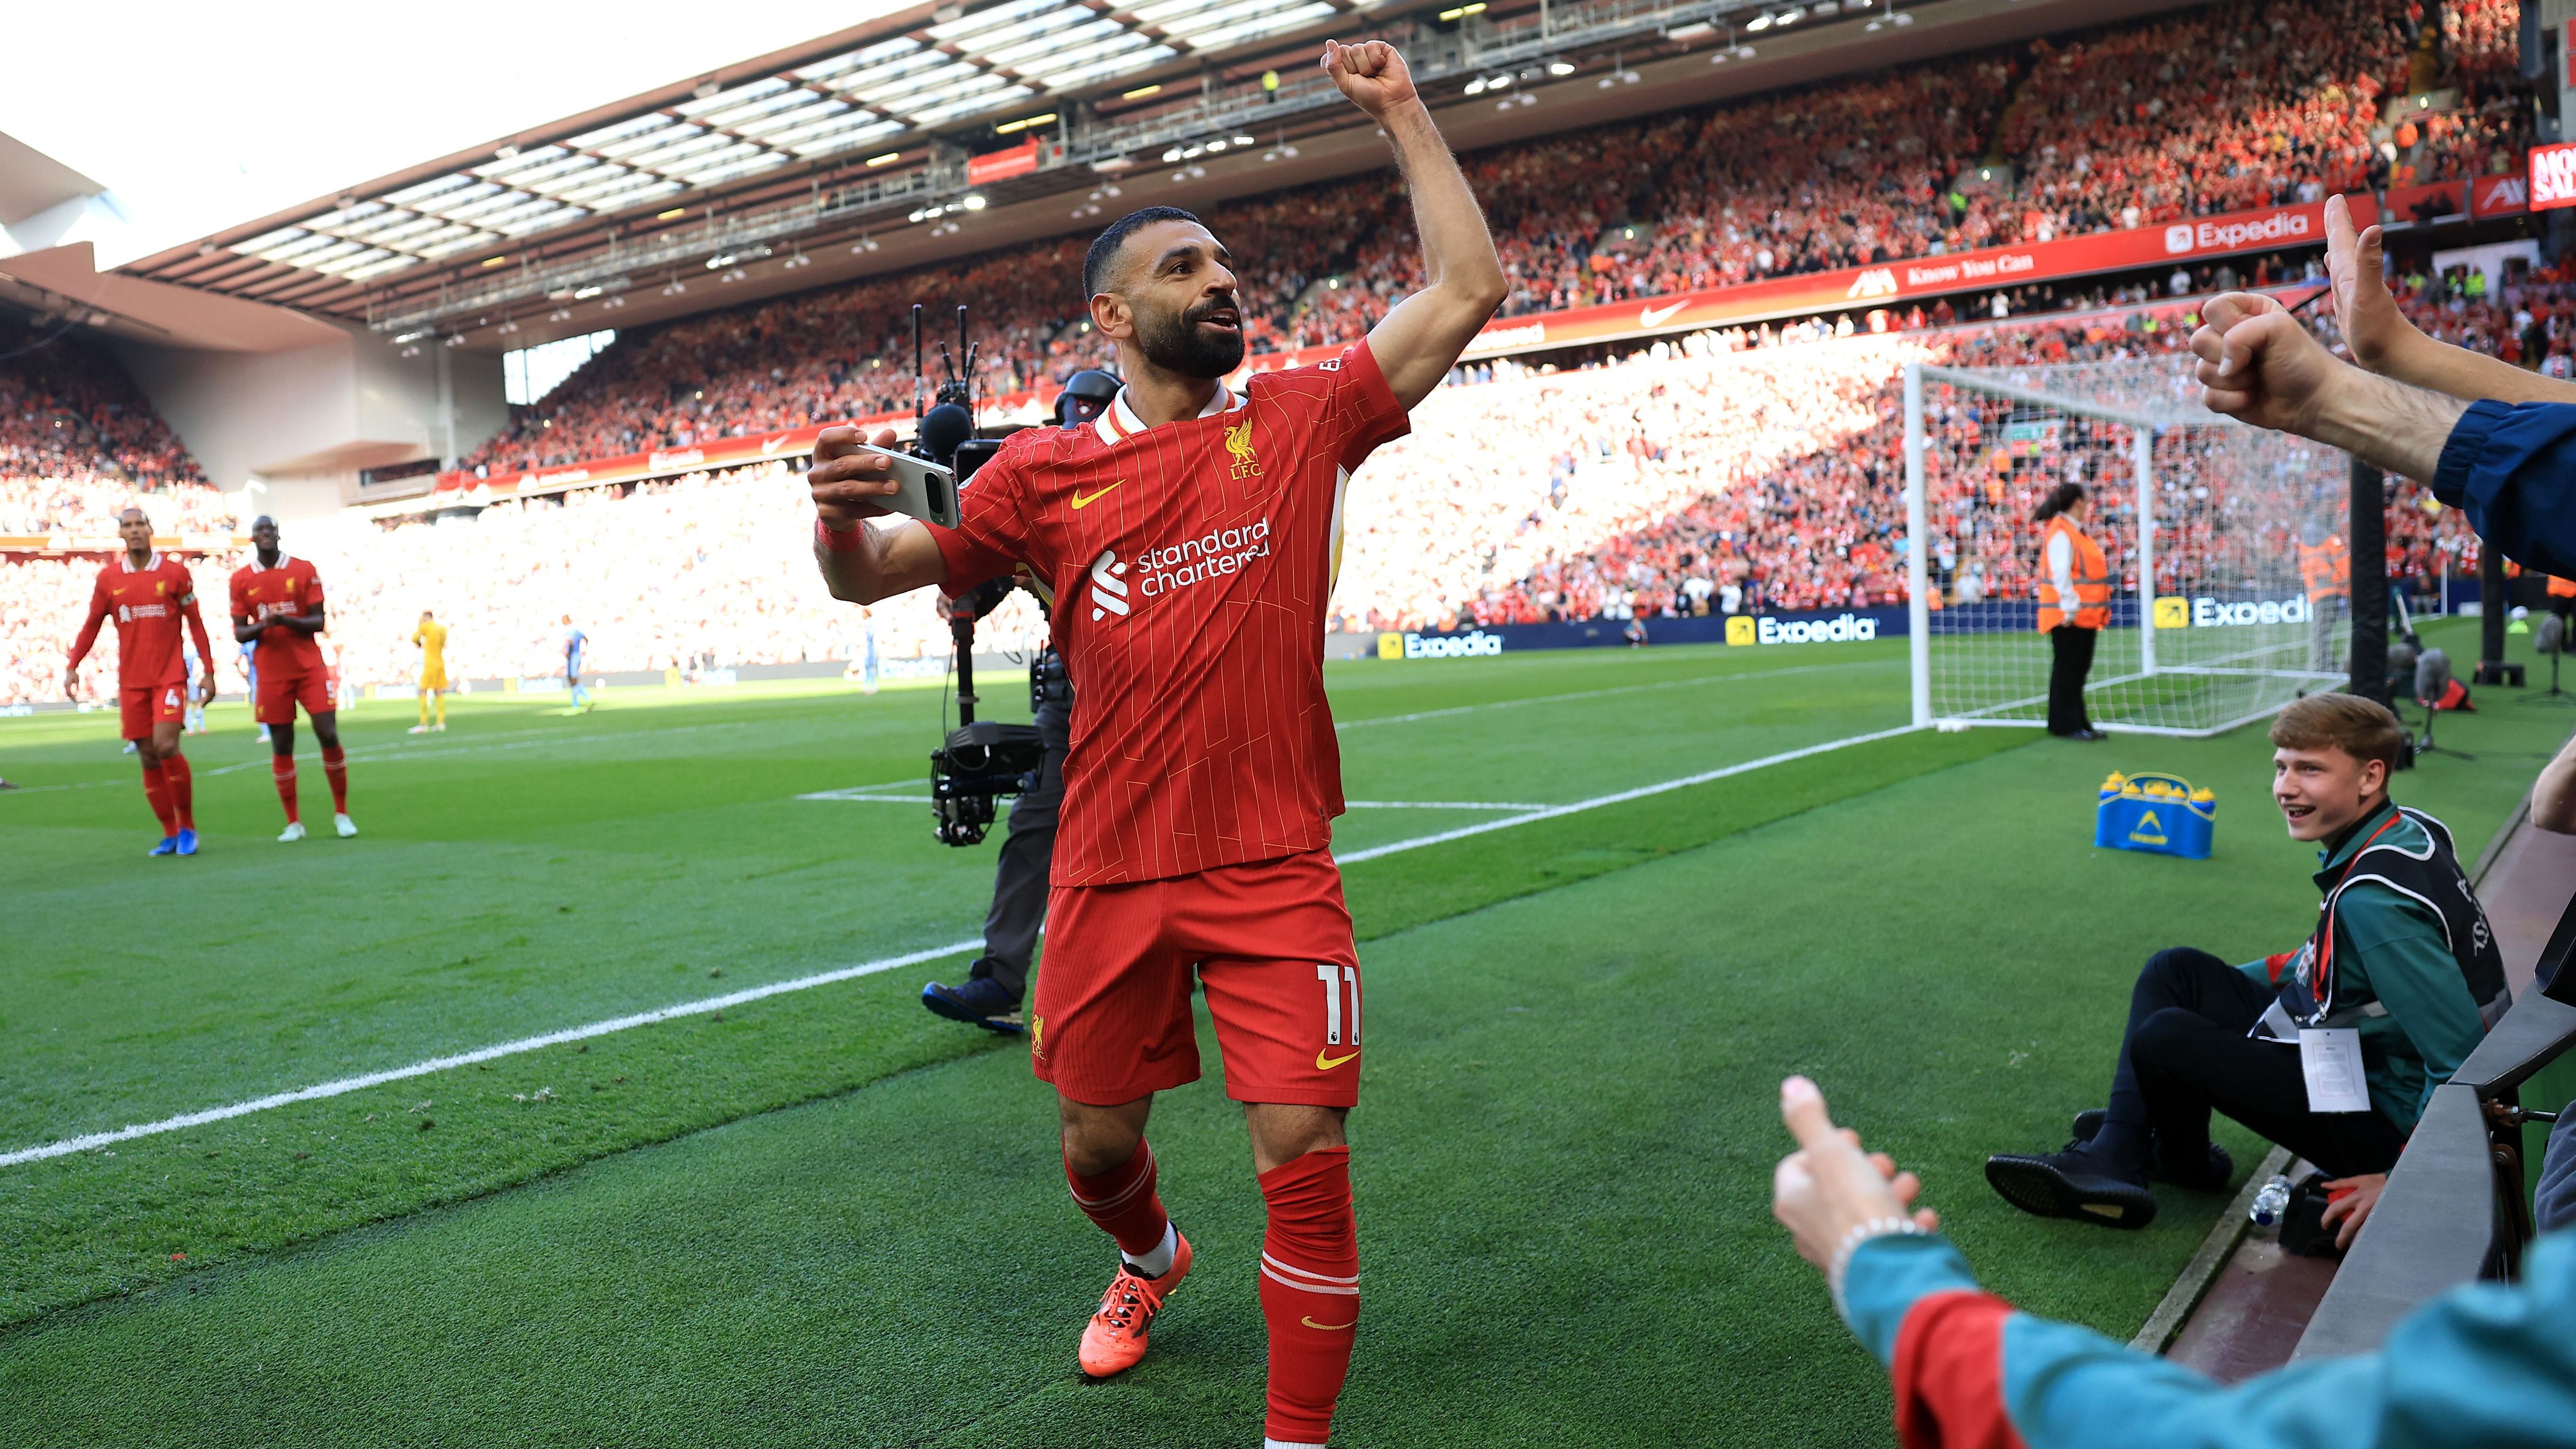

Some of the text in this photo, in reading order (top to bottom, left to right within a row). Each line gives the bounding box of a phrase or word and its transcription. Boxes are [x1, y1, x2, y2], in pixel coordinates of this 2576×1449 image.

[2534, 147, 2576, 179] MO
[2482, 177, 2527, 210] AX
[2198, 211, 2309, 248] Expedia
[1907, 265, 1960, 286] Know
[1961, 259, 1996, 278] You
[1997, 254, 2034, 273] Can
[1230, 464, 1265, 480] L.F.C.
[1138, 517, 1269, 573] standard
[1141, 538, 1270, 596] chartered
[2193, 593, 2314, 627] Expedi
[1404, 630, 1502, 659] Expedia
[1758, 613, 1876, 644] Expedia
[164, 689, 181, 707] 4
[1317, 965, 1360, 1046] 11
